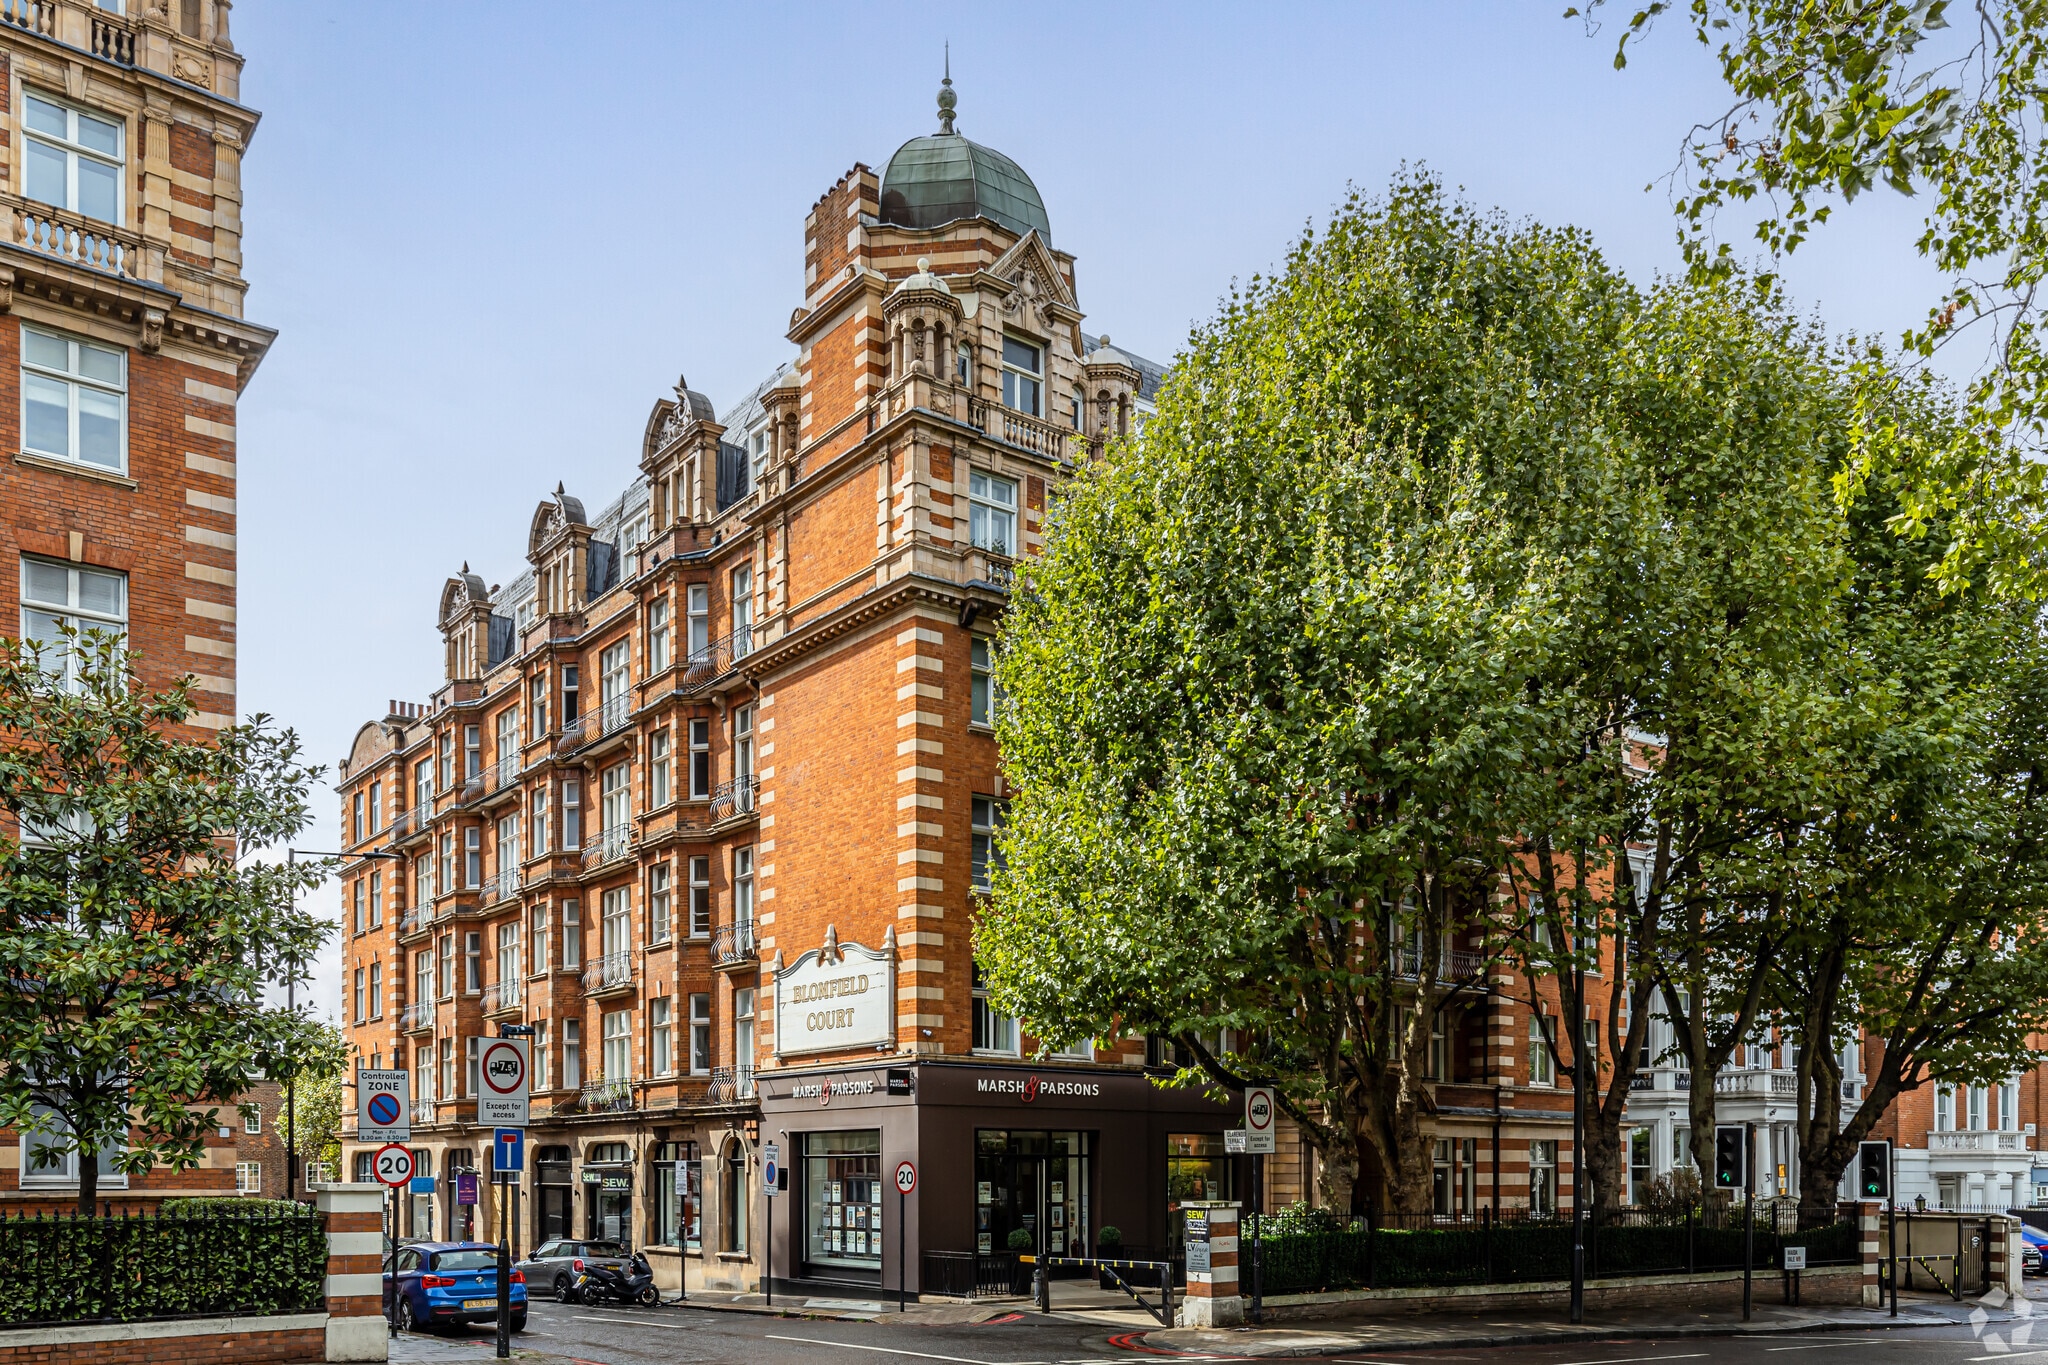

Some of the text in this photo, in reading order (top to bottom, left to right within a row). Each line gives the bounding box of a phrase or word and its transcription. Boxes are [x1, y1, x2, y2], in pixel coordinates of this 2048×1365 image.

[793, 974, 869, 1004] BLOMFIELD
[807, 1007, 855, 1031] COURT
[361, 1072, 406, 1080] Controlled
[368, 1082, 400, 1091] ZONE
[792, 1085, 822, 1098] MARSH
[831, 1080, 874, 1096] PARSONS
[977, 1079, 1025, 1093] MARSH
[1040, 1081, 1100, 1096] PARSONS
[486, 1102, 510, 1111] Except
[380, 1156, 410, 1174] 20
[602, 1178, 629, 1188] SEW.
[898, 1170, 914, 1185] 20
